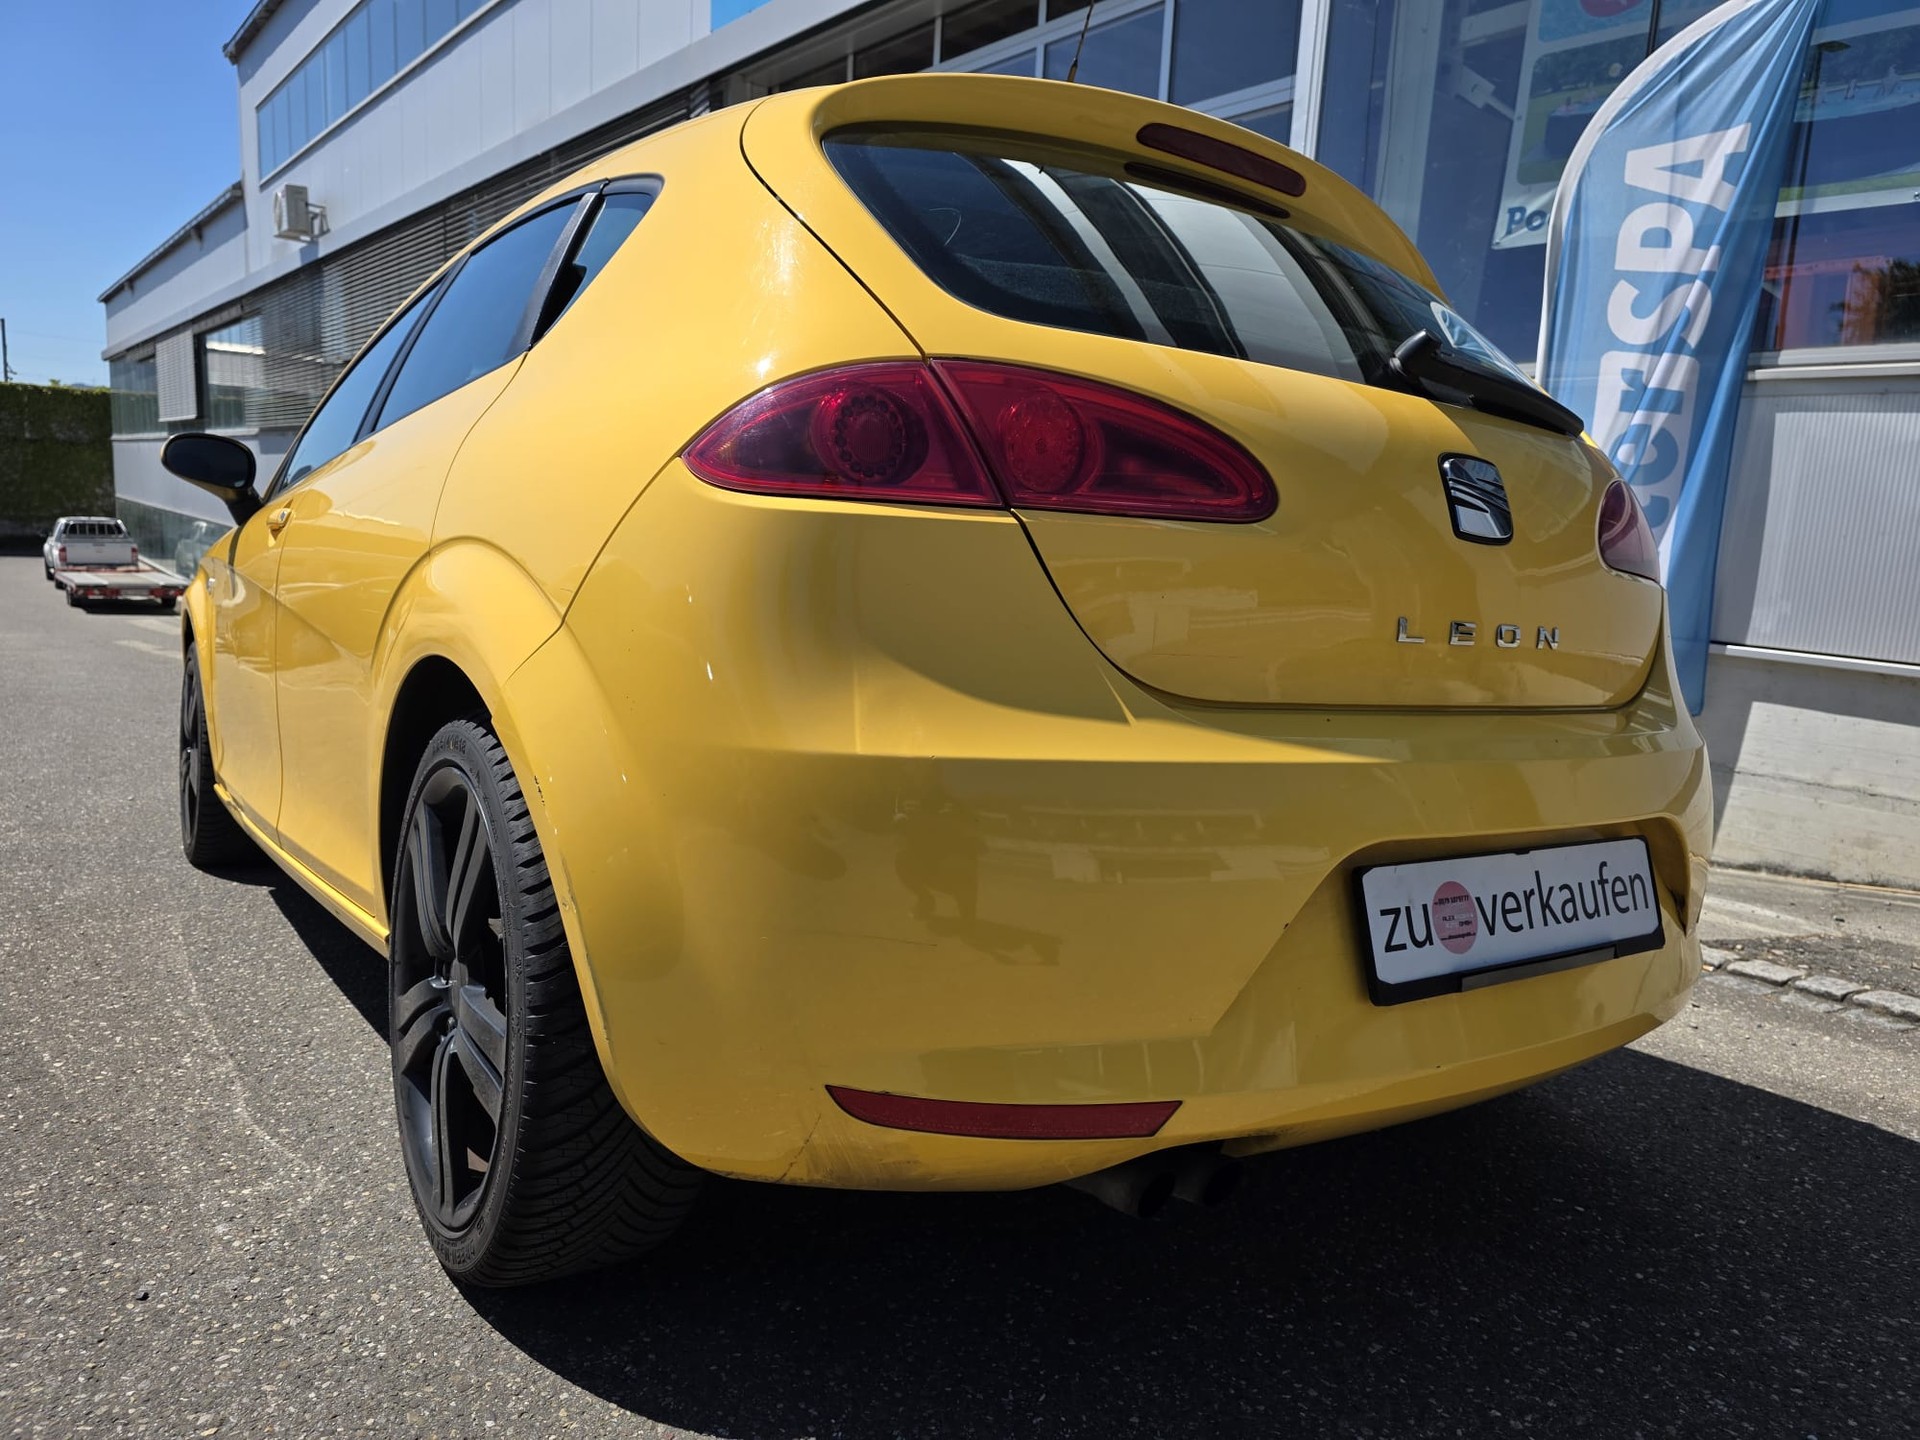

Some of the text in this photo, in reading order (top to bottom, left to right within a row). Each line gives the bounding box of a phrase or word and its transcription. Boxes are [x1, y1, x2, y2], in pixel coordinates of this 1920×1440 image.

[1505, 206, 1549, 236] Po
[1397, 616, 1559, 650] LEON
[1380, 861, 1650, 953] zu verkaufen
